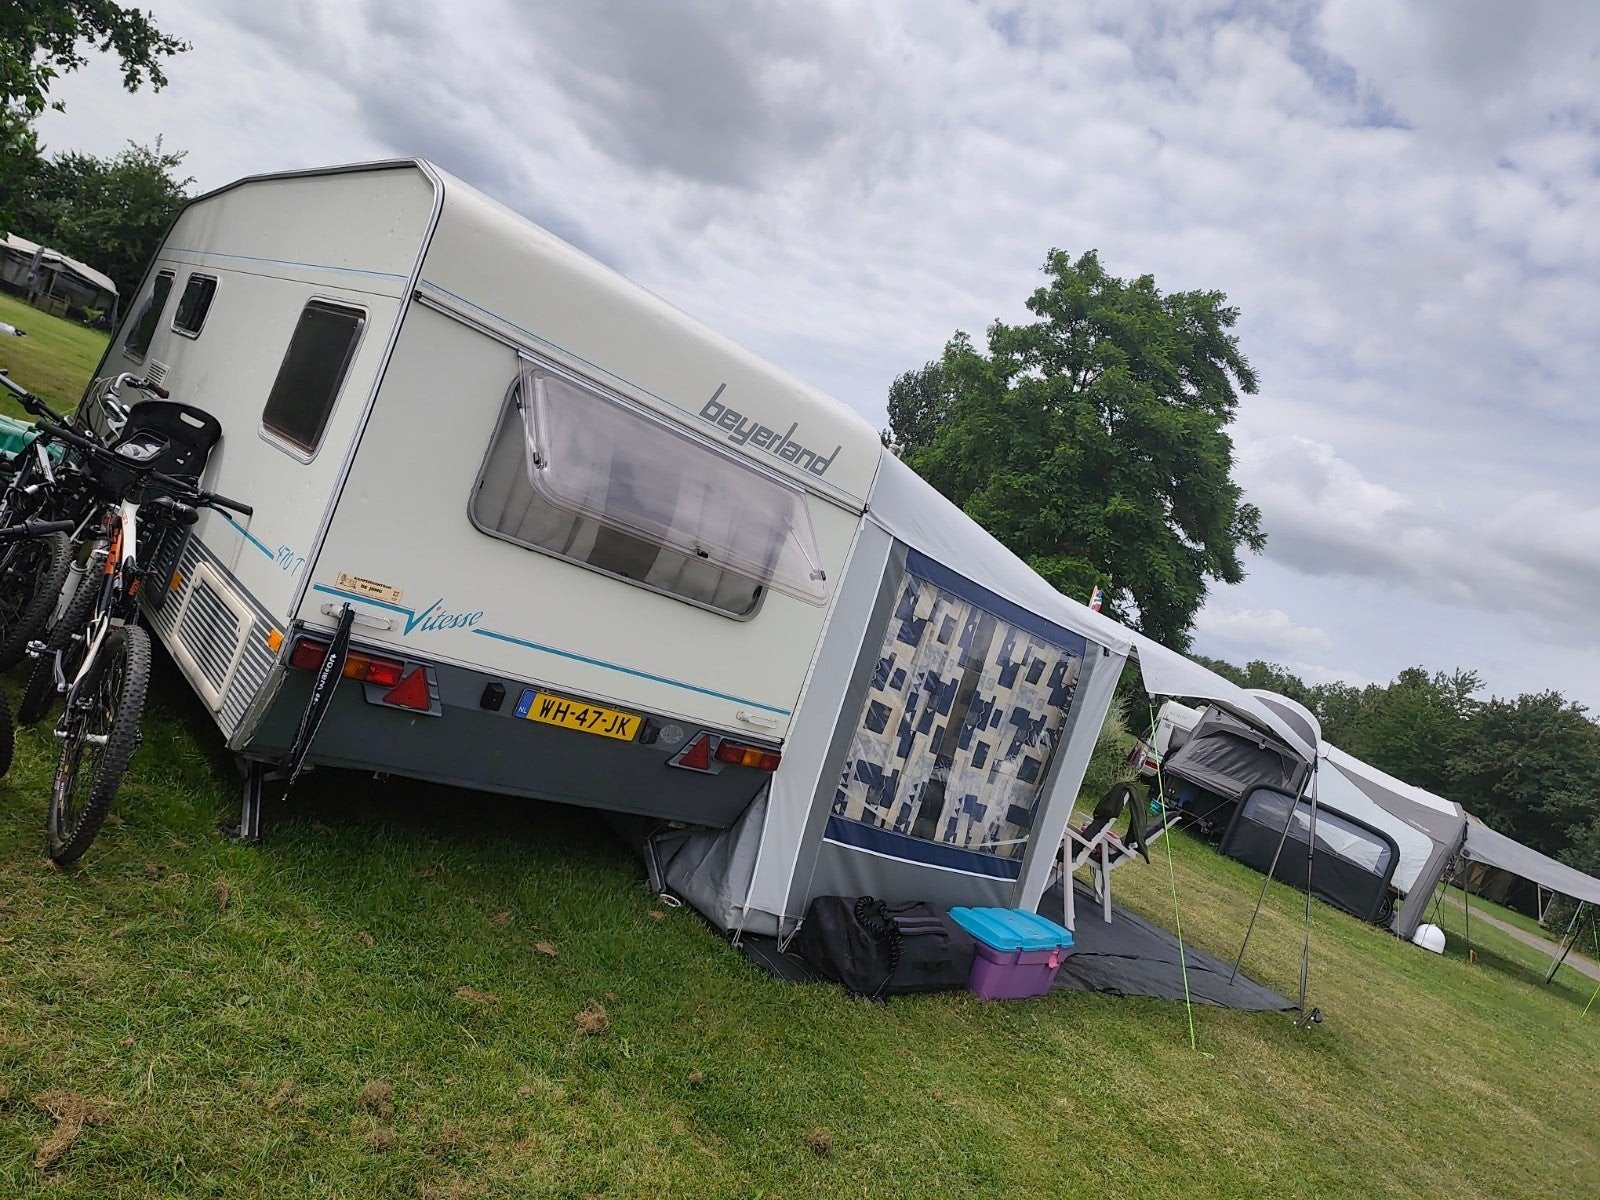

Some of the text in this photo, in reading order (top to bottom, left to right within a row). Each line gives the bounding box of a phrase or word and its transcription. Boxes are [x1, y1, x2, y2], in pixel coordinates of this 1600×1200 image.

[699, 382, 842, 477] beyerland
[277, 544, 306, 577] 470 T
[403, 597, 484, 637] Vitesse
[518, 705, 527, 714] NL
[539, 698, 631, 737] WH-47-JK
